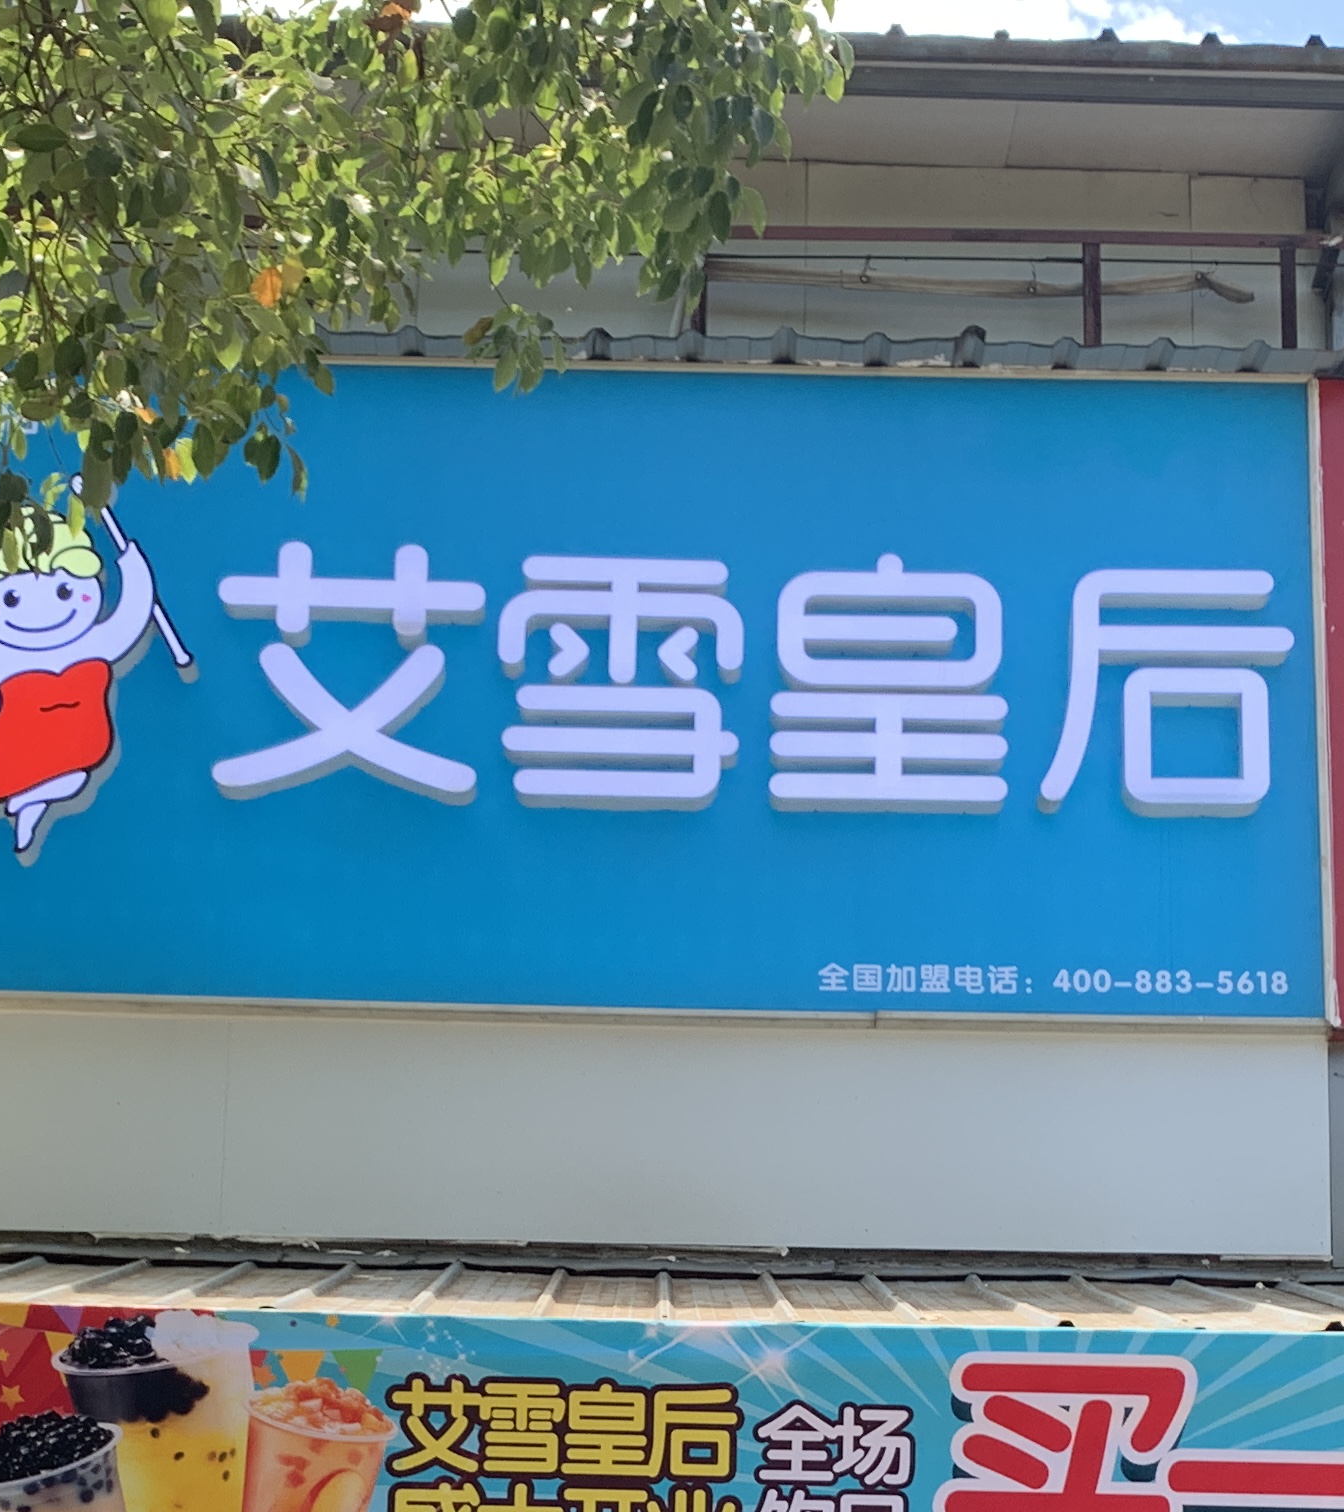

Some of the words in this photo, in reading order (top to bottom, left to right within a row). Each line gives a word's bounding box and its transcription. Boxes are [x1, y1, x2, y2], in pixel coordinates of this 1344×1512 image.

[212, 541, 1294, 815] 艾雪皇后
[1052, 969, 1289, 996] 400-883-5618
[390, 1373, 742, 1480] 艾雪皇后
[755, 1402, 913, 1487] 全场
